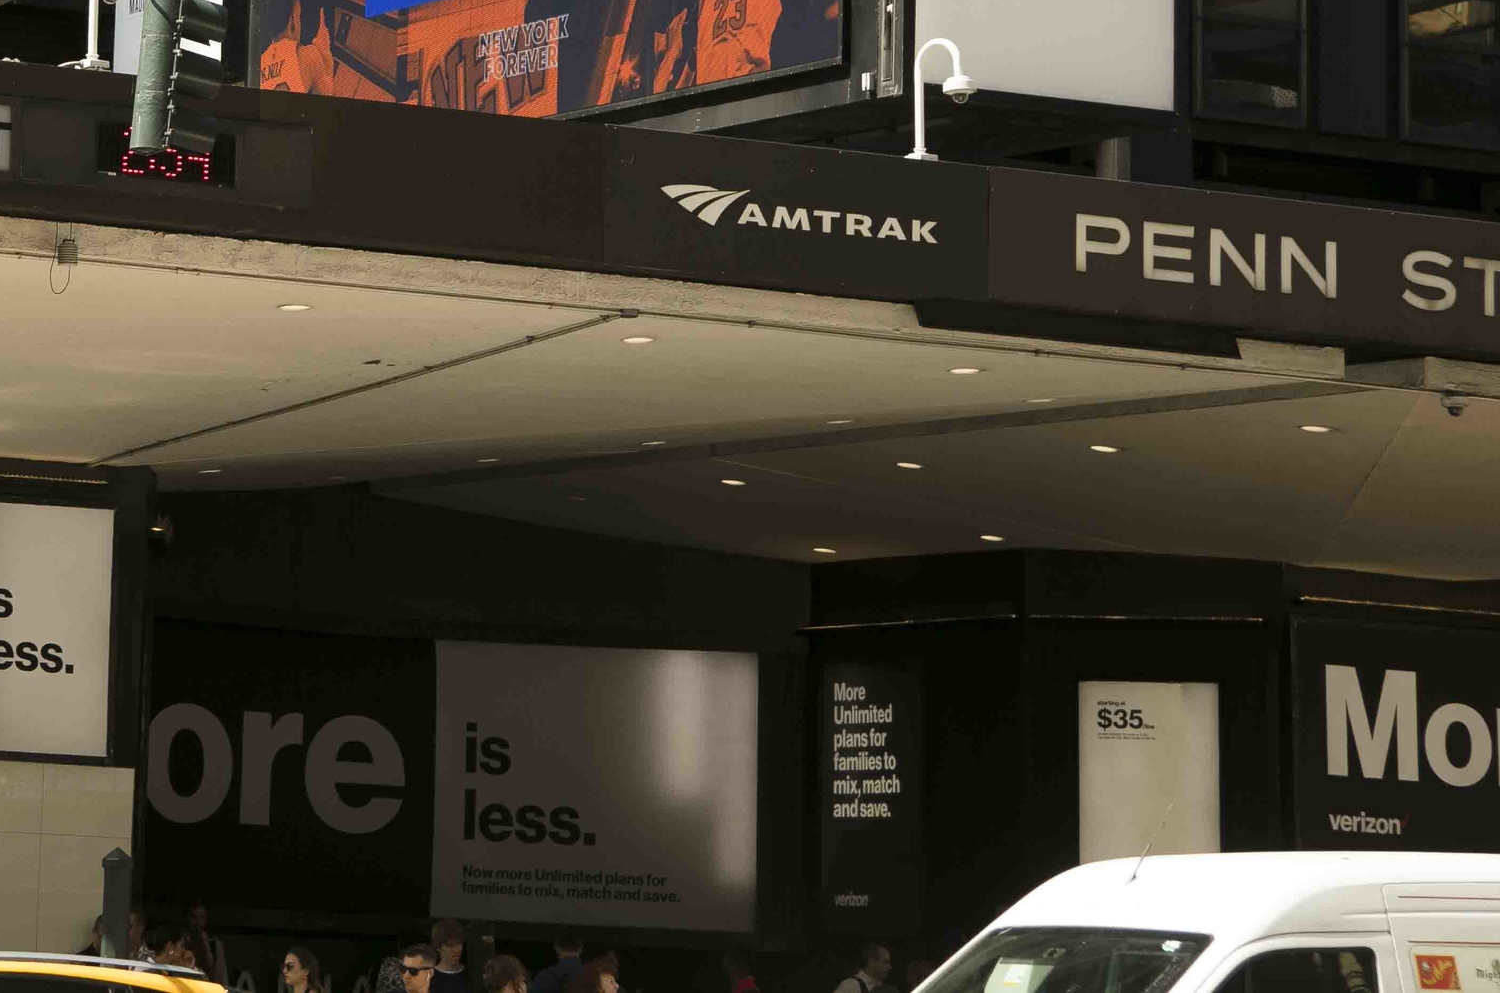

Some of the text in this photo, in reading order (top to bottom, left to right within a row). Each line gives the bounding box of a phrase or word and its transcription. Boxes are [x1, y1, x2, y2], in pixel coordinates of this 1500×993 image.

[478, 14, 569, 57] NEW YORK
[484, 45, 559, 83] FOREVER
[737, 202, 938, 244] AMTRAK
[1075, 212, 1337, 299] PENN
[834, 682, 866, 701] More
[833, 703, 893, 725] Unlimited
[1097, 707, 1143, 731] $35
[1325, 663, 1500, 787] Mo
[465, 722, 511, 776] is
[833, 727, 887, 751] plans for
[146, 703, 406, 834] ore
[833, 751, 897, 770] families to
[833, 774, 901, 798] mix, match
[463, 788, 597, 846] less.
[833, 798, 891, 818] and save.
[1329, 811, 1402, 835] verizon
[462, 865, 666, 887] Now more Unlimited plans for
[462, 881, 680, 903] families to mix, match and save.
[834, 890, 868, 907] verizon
